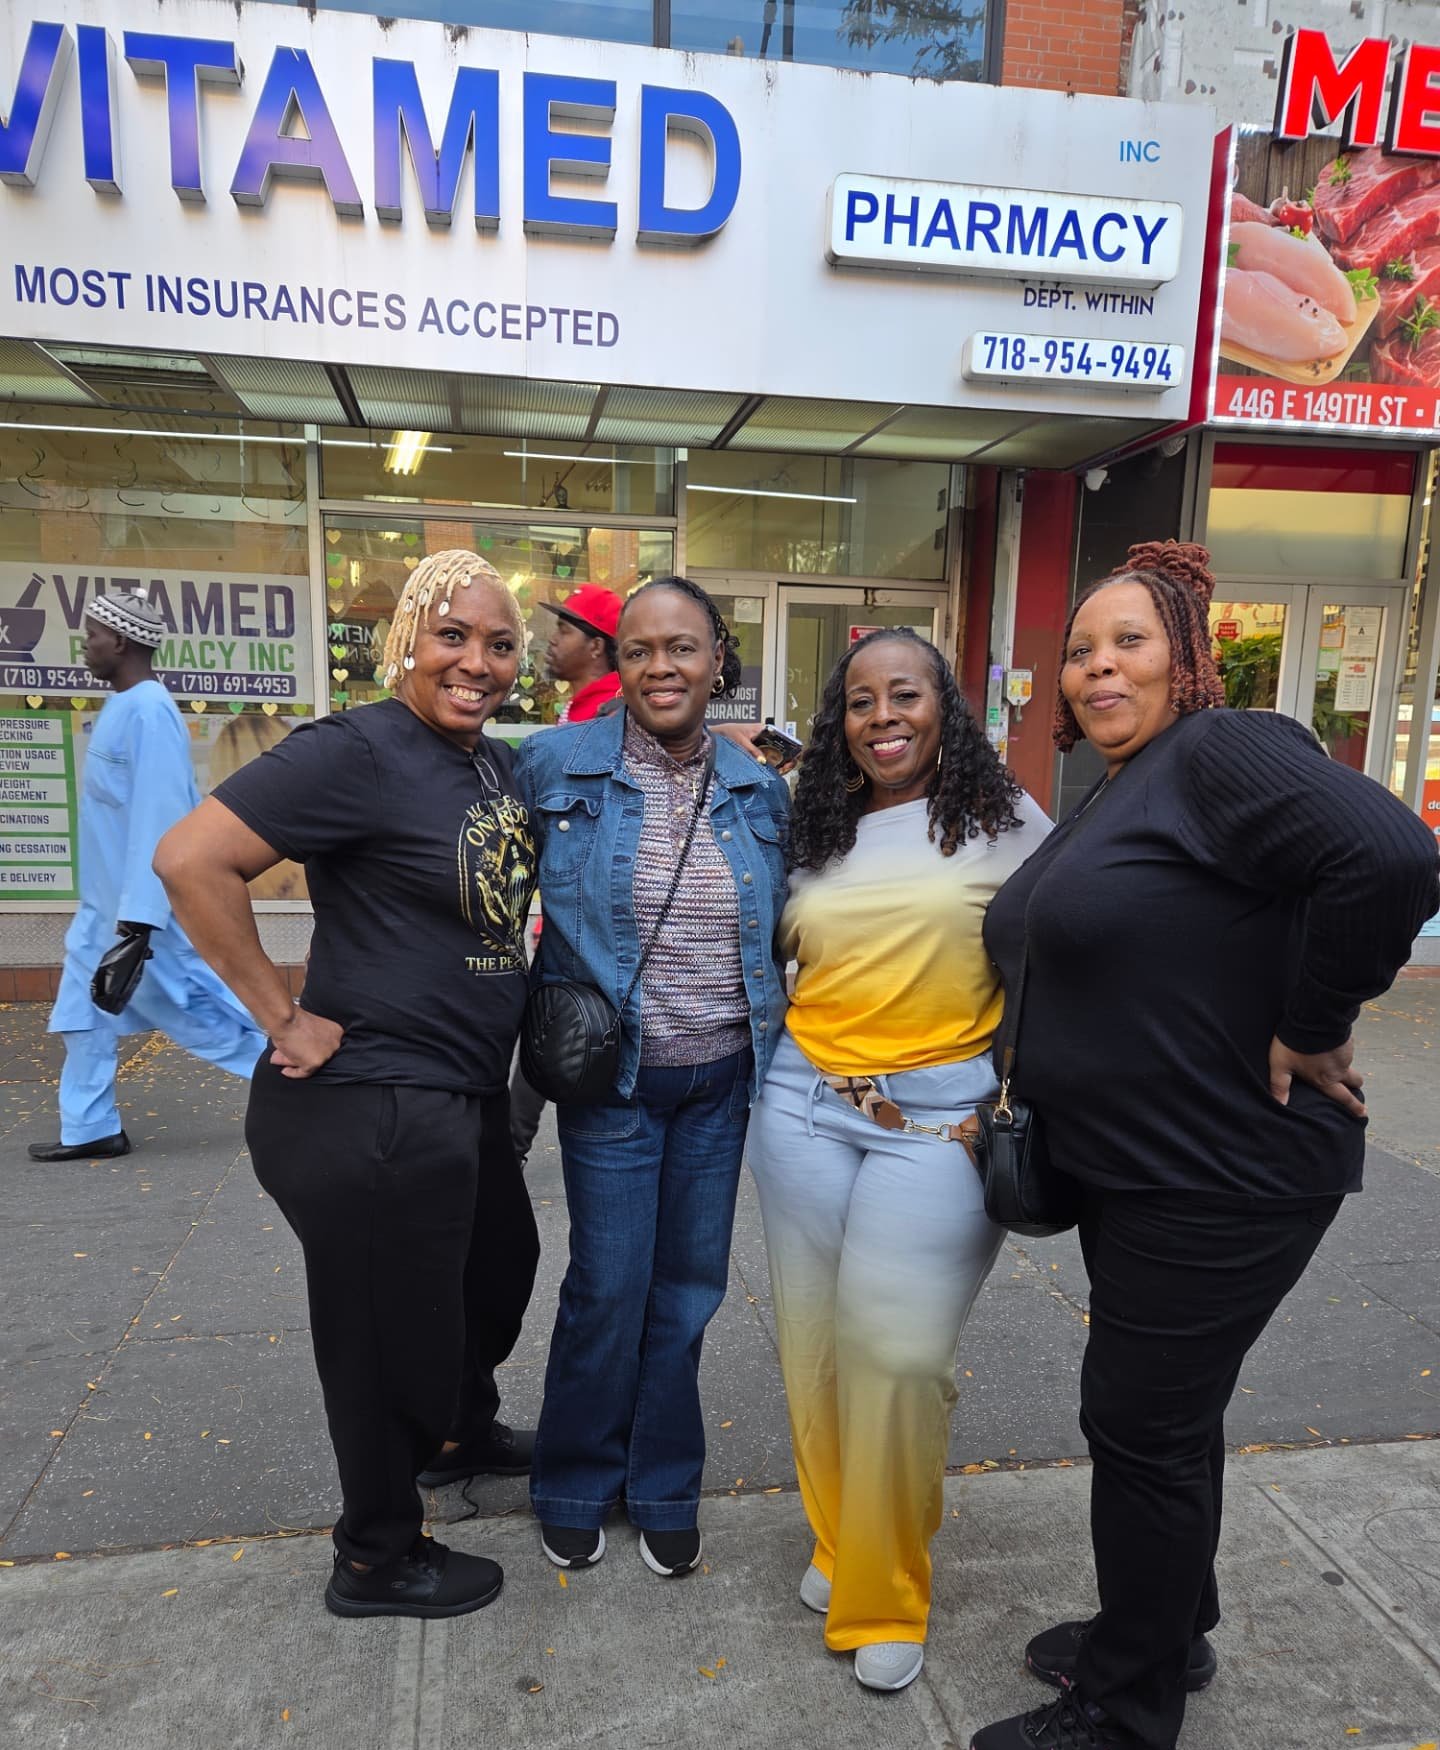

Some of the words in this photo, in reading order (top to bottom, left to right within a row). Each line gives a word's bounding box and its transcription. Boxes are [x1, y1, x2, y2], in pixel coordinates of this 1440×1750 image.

[1119, 141, 1161, 163] INC
[845, 190, 1168, 265] PHARMACY
[14, 264, 131, 310] MOST
[146, 274, 407, 331] INSURANCES
[417, 297, 620, 348] ACCEPTED
[1023, 287, 1076, 310] DEPT.
[1085, 291, 1154, 316] WITHIN
[982, 335, 1172, 381] 718-954-9494
[1229, 387, 1275, 419] 446
[1282, 389, 1297, 420] E
[1304, 391, 1372, 425] 149TH
[1378, 396, 1408, 427] ST
[1358, 627, 1365, 635] A
[69, 635, 237, 670] PMACY
[249, 642, 295, 672] INC
[4, 667, 42, 687] (718)
[182, 673, 218, 693] (718)
[223, 675, 290, 694] 691-4953
[0, 719, 50, 730] PRESSURE
[0, 749, 22, 760] TION
[25, 750, 57, 760] USAGE
[15, 843, 67, 854] CESSATION
[10, 872, 57, 883] DELIVERY
[465, 956, 497, 971] THE
